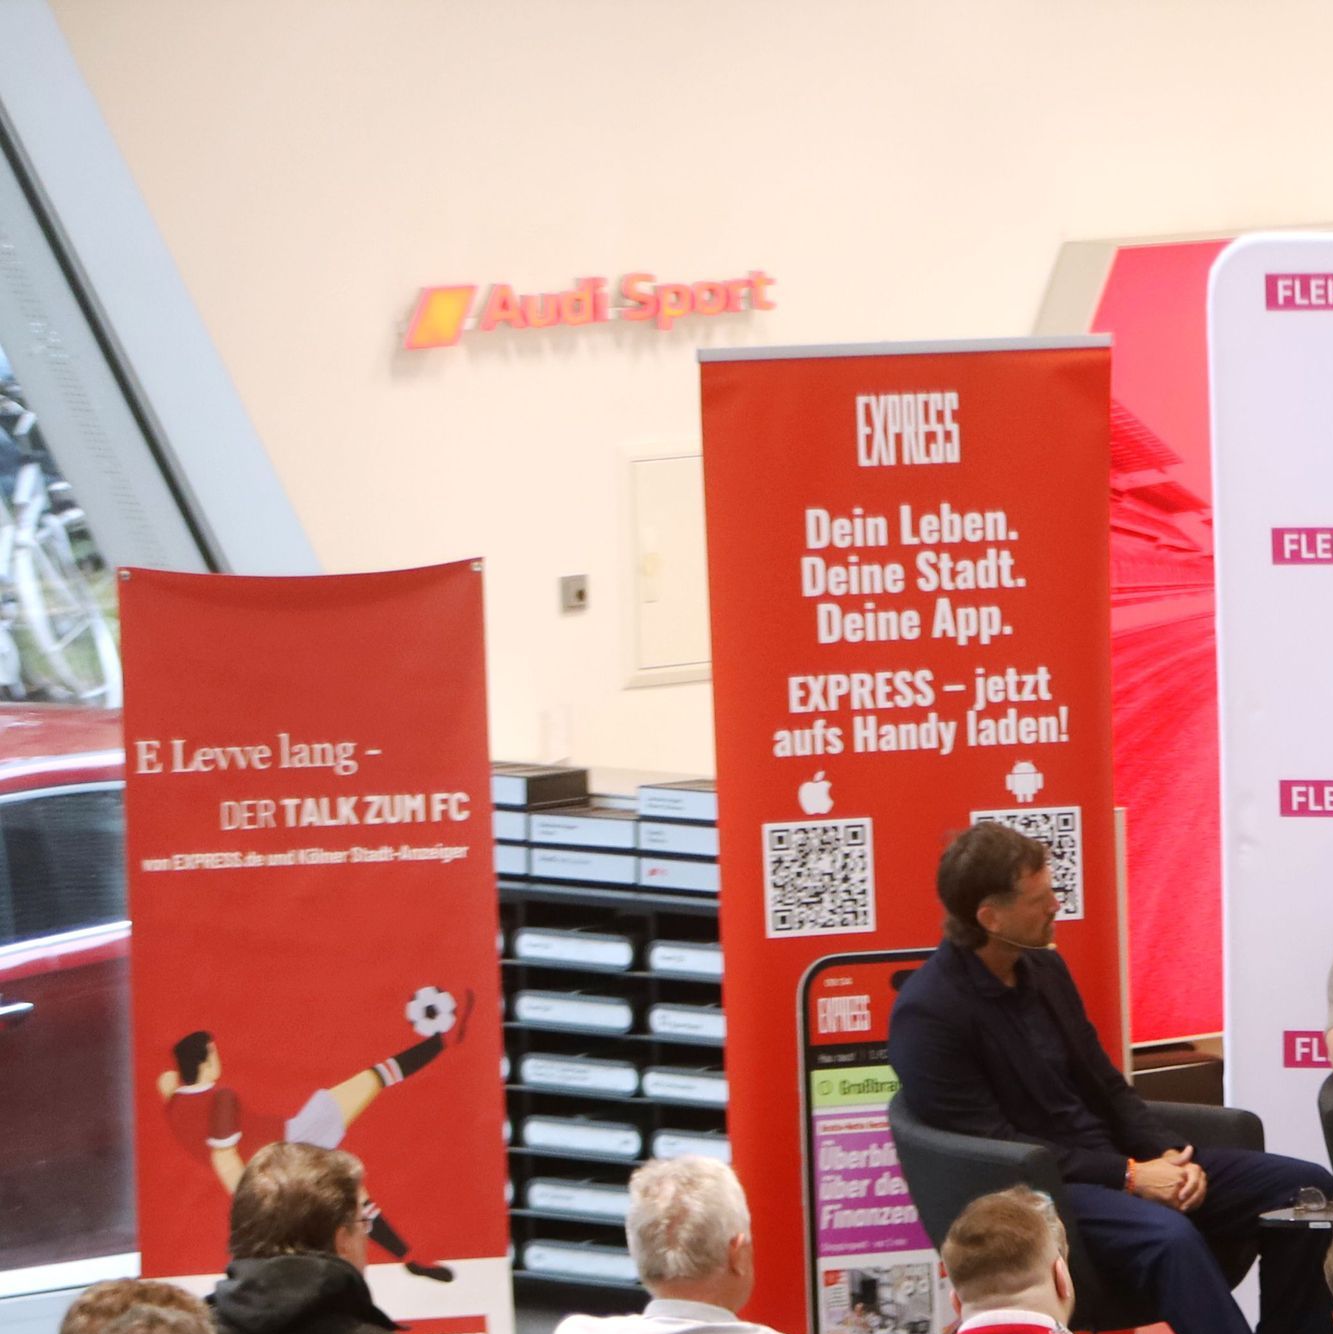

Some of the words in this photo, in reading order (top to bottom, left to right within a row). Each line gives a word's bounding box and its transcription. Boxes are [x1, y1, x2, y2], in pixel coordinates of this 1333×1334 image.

[480, 274, 609, 331] Audi
[621, 270, 777, 331] Sport
[856, 392, 960, 467] EXPRESS
[805, 507, 888, 549] Dein
[899, 502, 1018, 545] Leben.
[801, 555, 905, 597] Deine
[916, 547, 1027, 592] Stadt.
[816, 602, 921, 644] Deine
[931, 597, 1013, 646] App.
[788, 669, 935, 713] EXPRESS
[973, 666, 1052, 711] jetzt
[134, 740, 163, 775] E
[171, 739, 273, 774] Levve
[277, 732, 360, 777] lang
[772, 718, 844, 758] aufs
[853, 711, 958, 756] Handy
[966, 705, 1069, 747] laden!
[220, 800, 277, 831] DER
[280, 796, 360, 828] TALK
[363, 794, 426, 825] ZUM
[431, 792, 472, 822] FC
